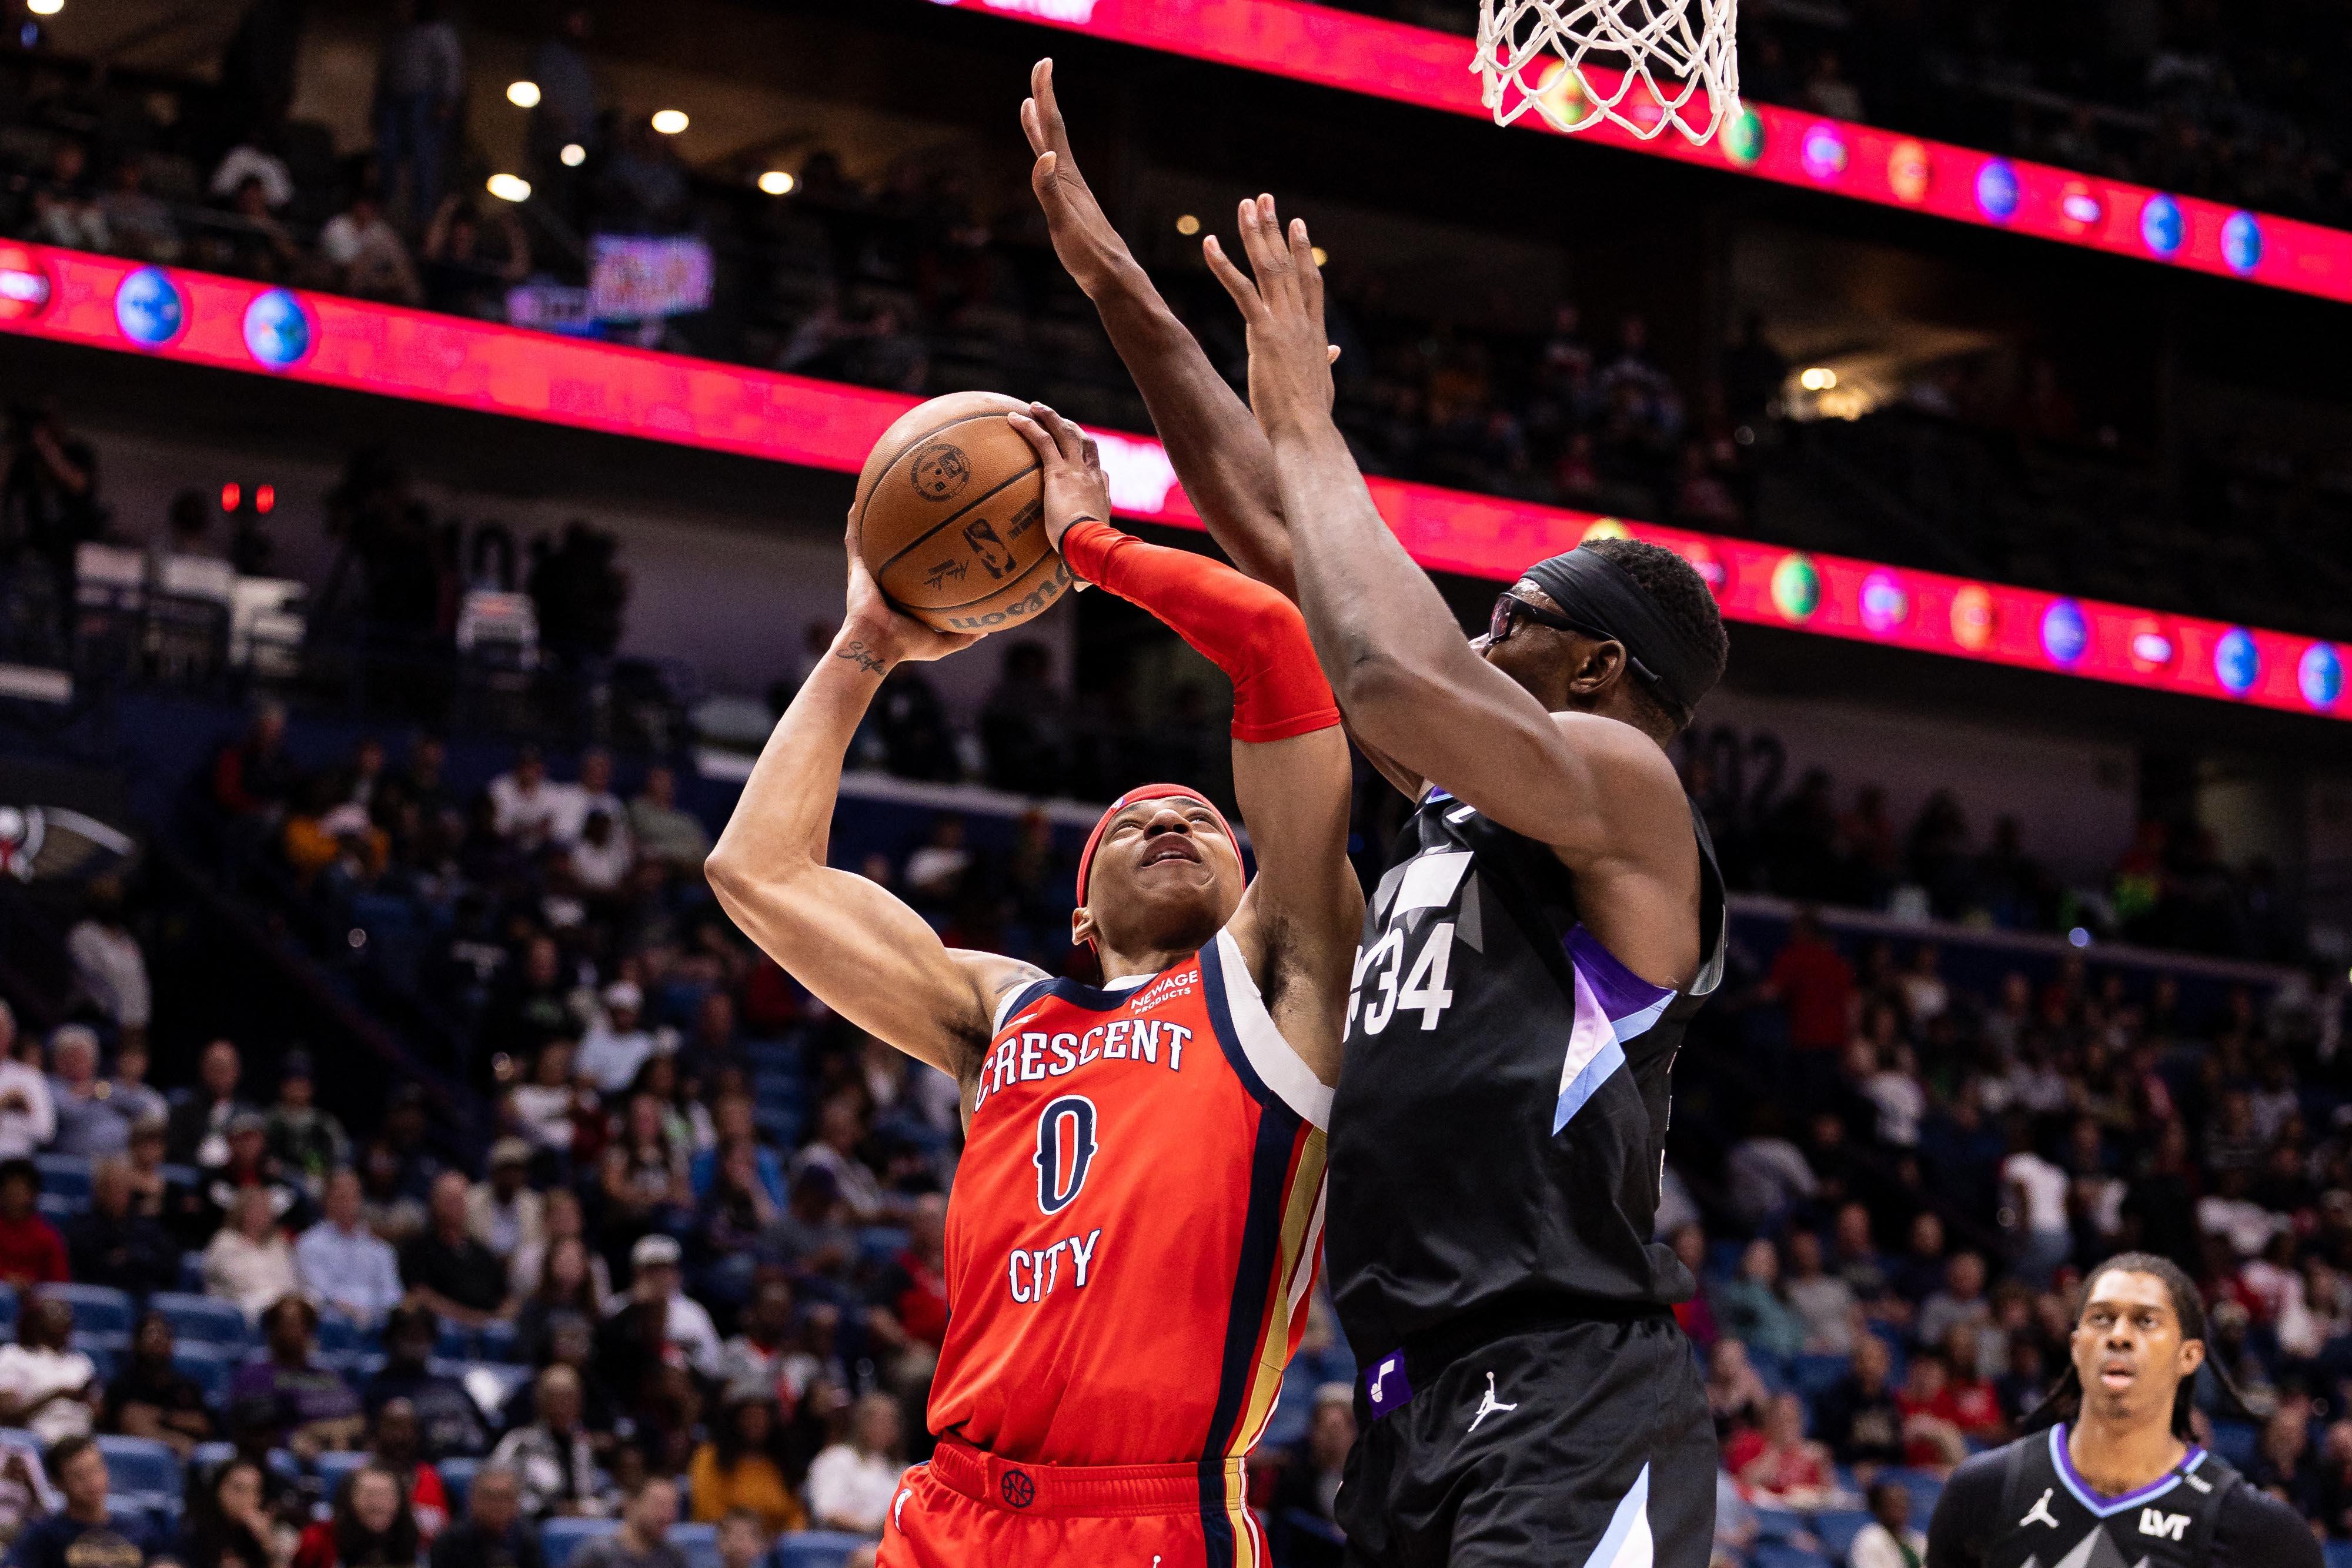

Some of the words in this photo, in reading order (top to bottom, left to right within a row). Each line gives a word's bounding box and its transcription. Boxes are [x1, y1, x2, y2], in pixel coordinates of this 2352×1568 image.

[1131, 969, 1198, 1009] NEWAGE
[1134, 987, 1191, 1015] PRODUCTS
[1364, 922, 1455, 1035] 34
[974, 1018, 1193, 1112] CRESCENT
[1033, 1094, 1099, 1216] 0
[1008, 1228, 1102, 1304] CITY
[2139, 1507, 2191, 1541] LVT
